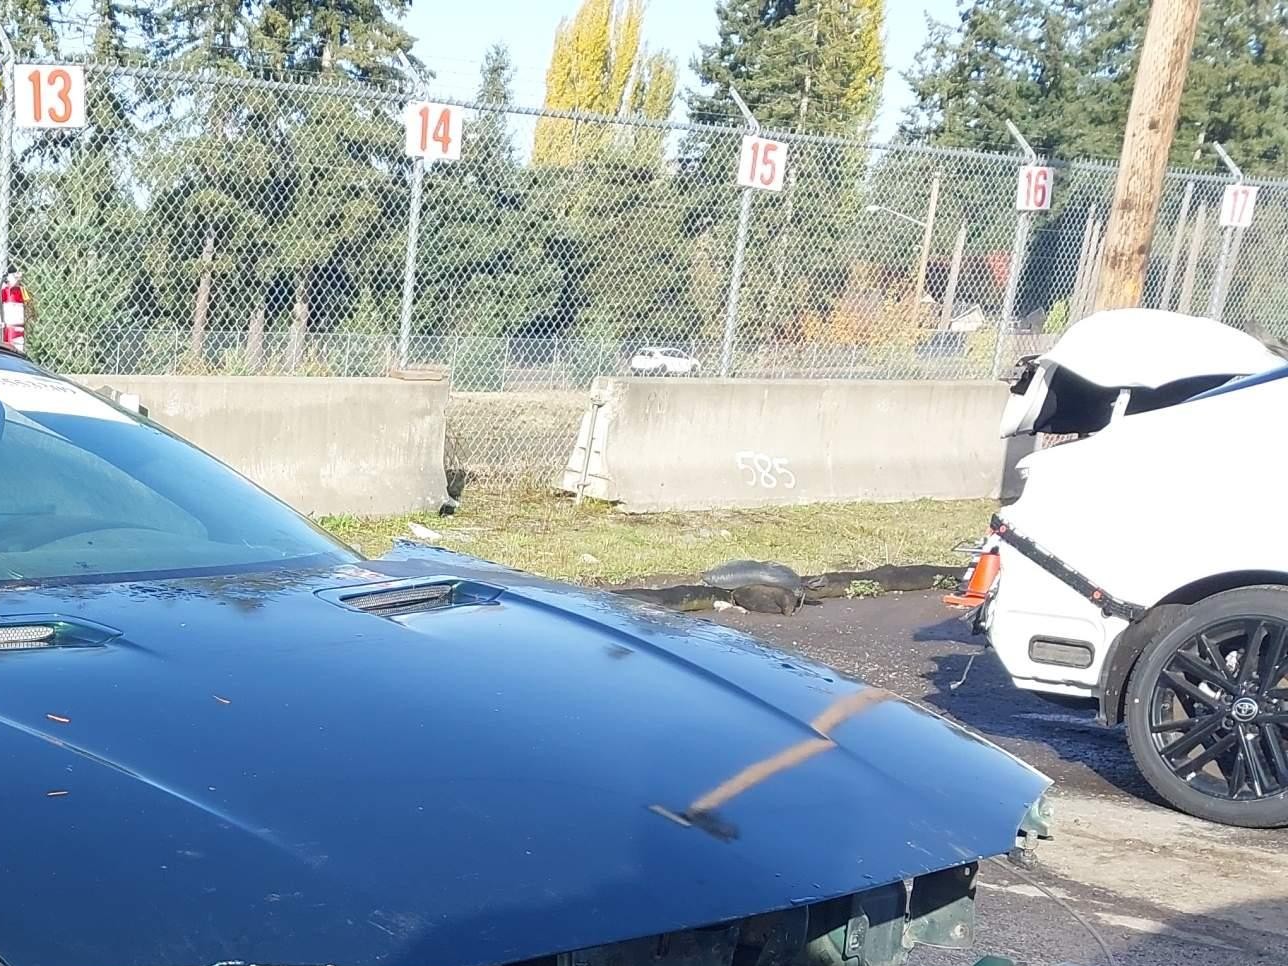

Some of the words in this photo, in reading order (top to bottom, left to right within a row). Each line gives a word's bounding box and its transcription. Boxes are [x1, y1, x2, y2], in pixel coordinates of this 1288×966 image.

[28, 69, 72, 123] 13
[419, 106, 451, 153] 14
[750, 142, 777, 186] 15
[1026, 169, 1047, 207] 16
[1231, 189, 1249, 223] 17
[735, 450, 796, 489] 585
